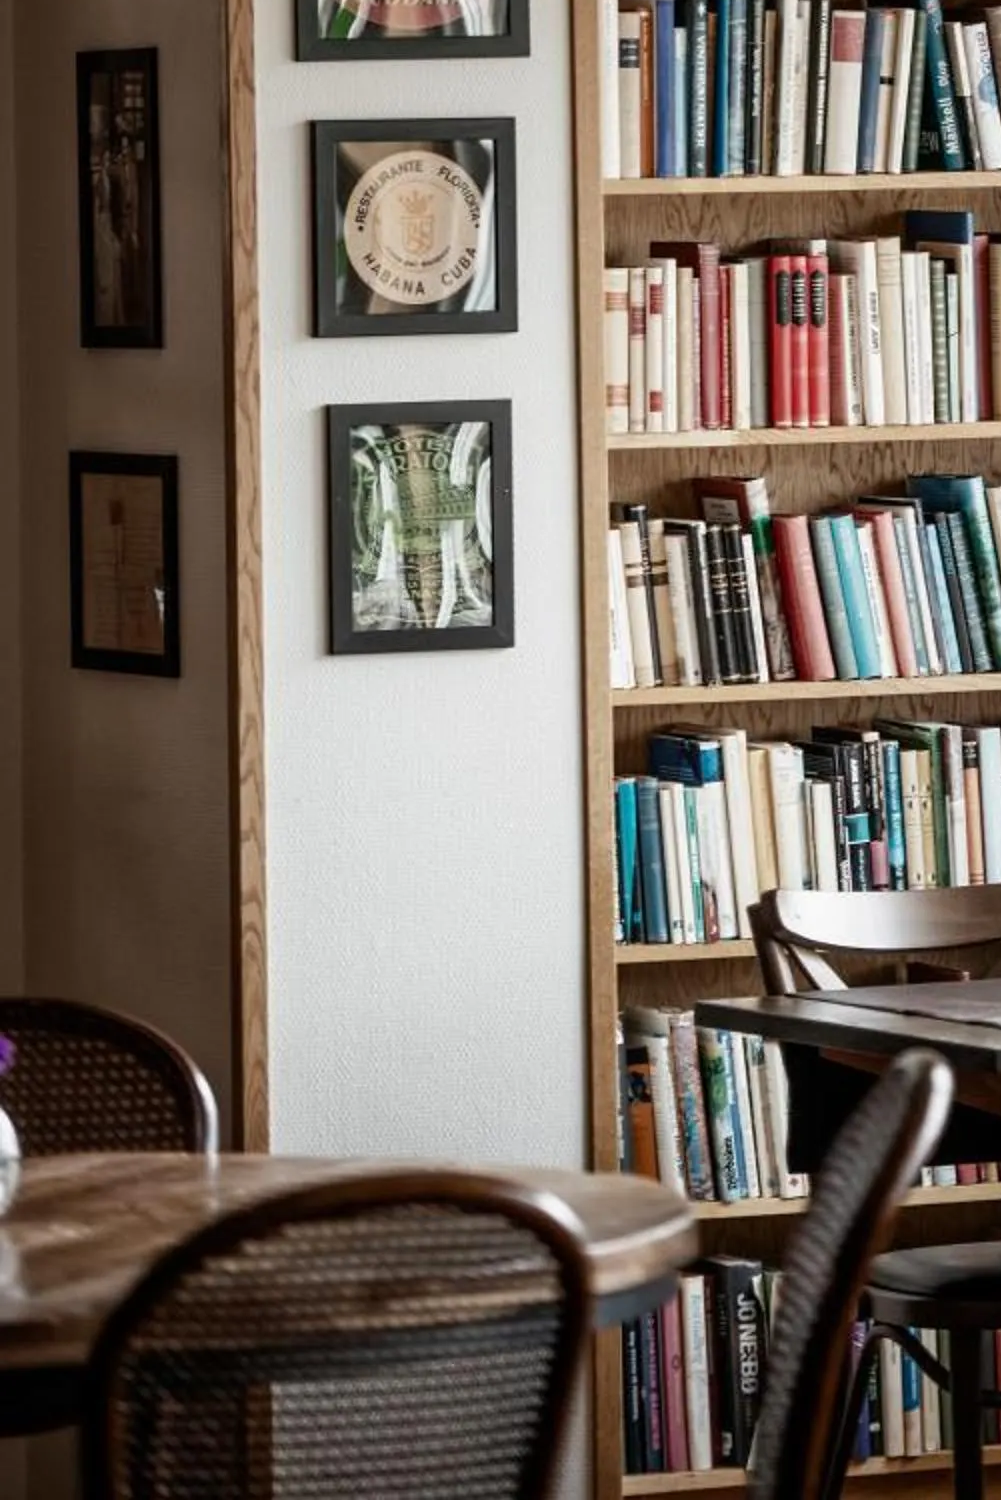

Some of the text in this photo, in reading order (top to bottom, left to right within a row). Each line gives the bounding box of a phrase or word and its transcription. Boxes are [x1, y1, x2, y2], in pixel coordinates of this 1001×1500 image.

[355, 160, 481, 223] RESTAURANTE FLORIDITA
[363, 252, 426, 296] HABANA
[441, 247, 477, 286] CUBA
[737, 1293, 759, 1394] JO NESBØ
